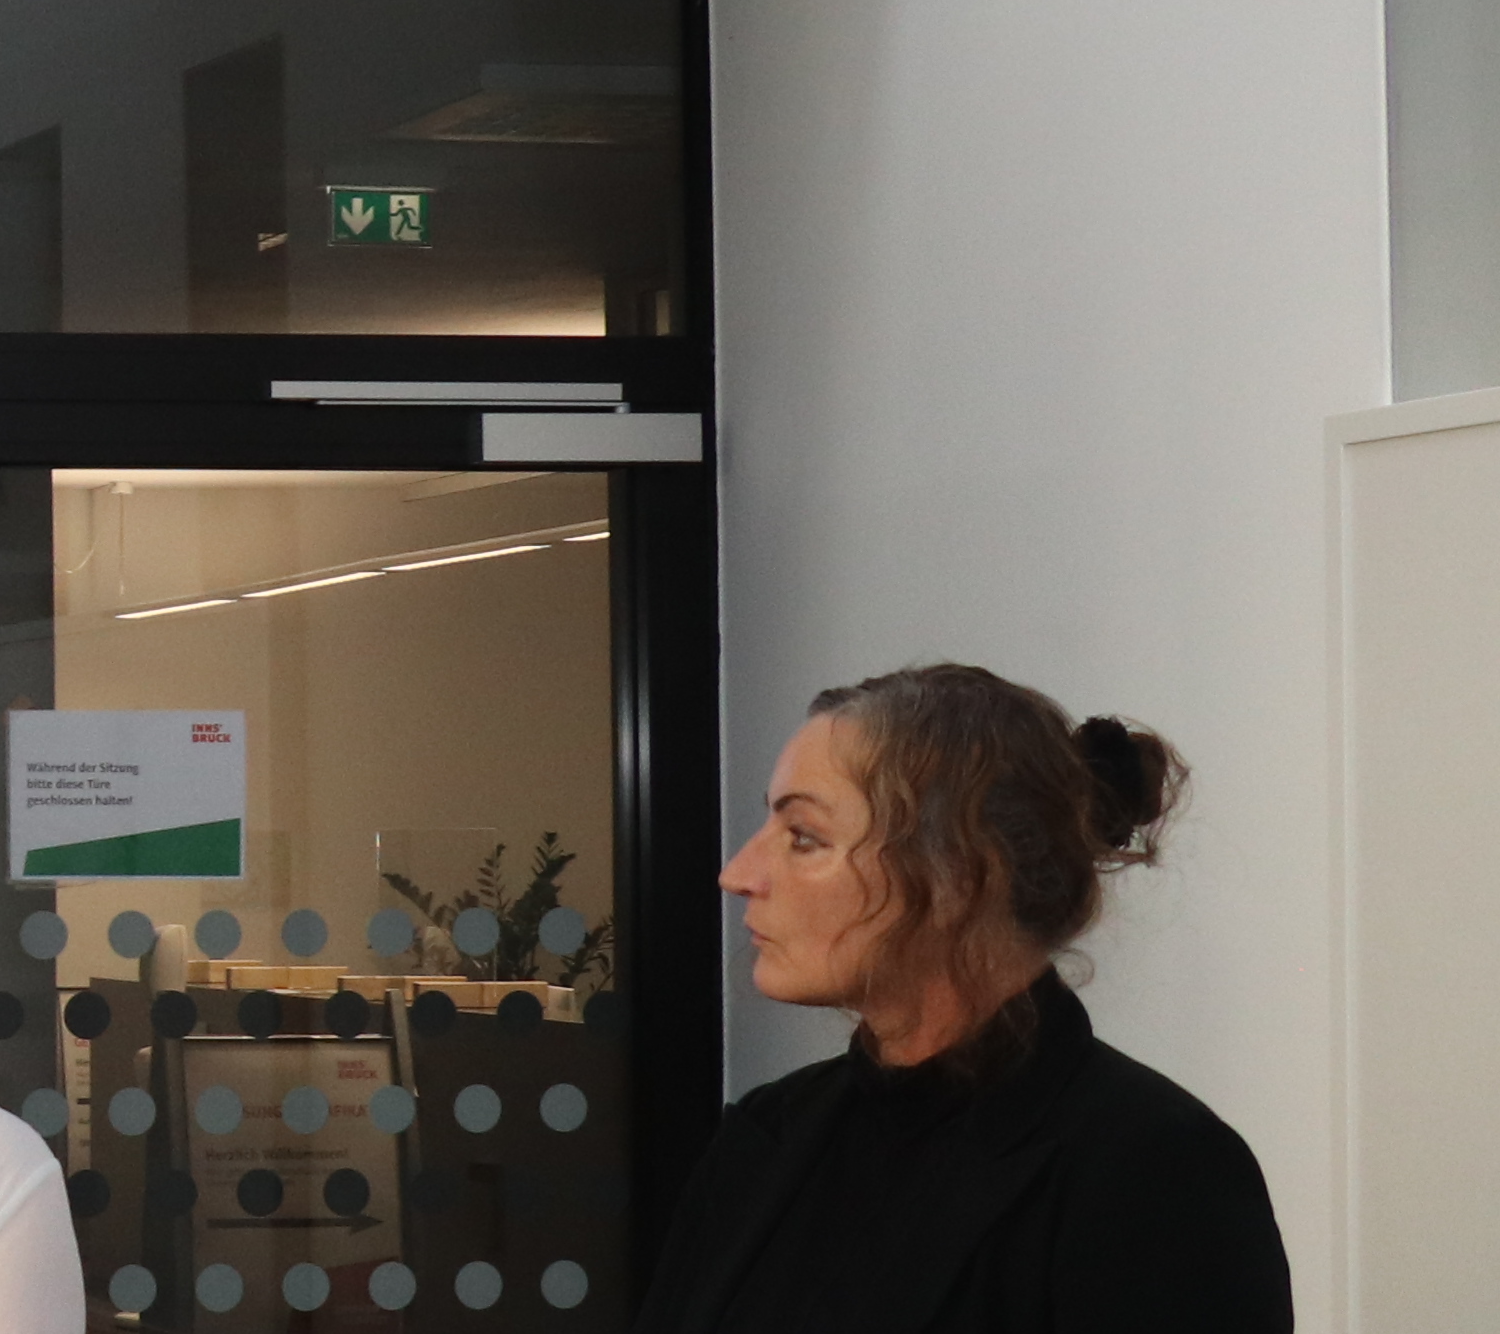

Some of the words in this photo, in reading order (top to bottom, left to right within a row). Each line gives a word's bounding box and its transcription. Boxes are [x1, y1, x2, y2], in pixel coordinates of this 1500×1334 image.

[26, 762, 76, 773] Während
[78, 762, 97, 773] der
[99, 762, 140, 776] Sitzung
[26, 778, 53, 790] bitte
[55, 778, 84, 790] diese
[26, 794, 93, 809] geschlossen
